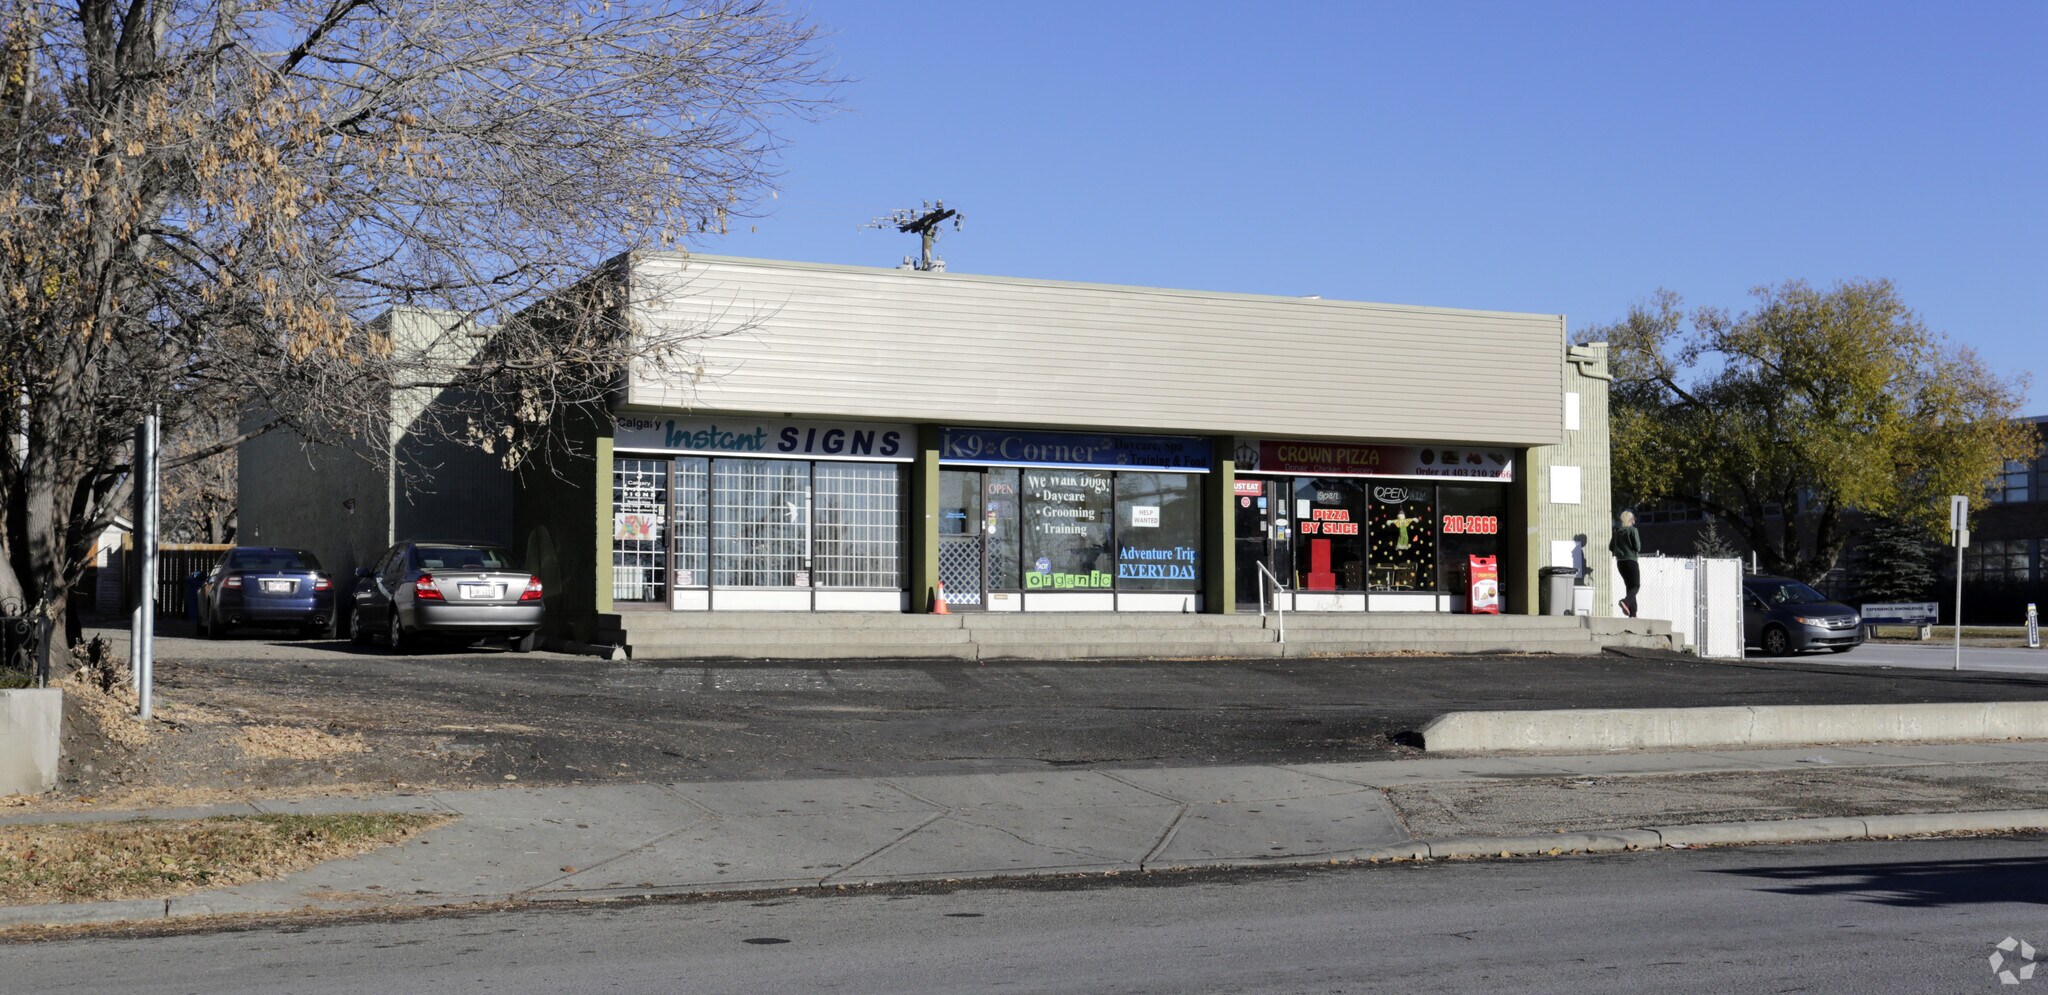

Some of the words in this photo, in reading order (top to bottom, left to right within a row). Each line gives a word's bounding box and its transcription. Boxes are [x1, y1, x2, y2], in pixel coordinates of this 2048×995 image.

[618, 417, 661, 431] Calgary
[665, 420, 768, 451] Instant
[778, 426, 900, 456] SIGNS
[943, 434, 983, 459] K9
[1000, 436, 1099, 462] Corner
[1115, 439, 1160, 453] Daycare,
[1164, 441, 1183, 454] Spa
[1130, 453, 1170, 469] Training
[1173, 455, 1181, 466] &
[1184, 456, 1207, 467] Food
[1277, 445, 1332, 464] CROWN
[1336, 448, 1379, 465] PIZZA
[1314, 465, 1341, 473] Chicken
[1347, 466, 1374, 475] Grocery
[1416, 467, 1438, 476] Order
[1471, 469, 1487, 477] 210
[1490, 470, 1512, 478] 2666
[988, 484, 1013, 494] OPEN
[1028, 476, 1046, 490] We
[1080, 476, 1111, 494] Dogs!
[1043, 490, 1085, 503] Daycare
[1317, 491, 1339, 501] Open
[1375, 486, 1408, 500] OPEN
[1042, 506, 1095, 520] Grooming
[1312, 508, 1350, 521] PIZZA
[1042, 523, 1087, 537] Training
[1301, 522, 1320, 534] BY
[1322, 522, 1358, 535] SLICE
[1443, 515, 1498, 534] 210-2666
[1119, 546, 1173, 560] Adventure
[1119, 563, 1166, 577] EVERY
[1169, 564, 1195, 578] DAY
[1030, 573, 1111, 586] organic
